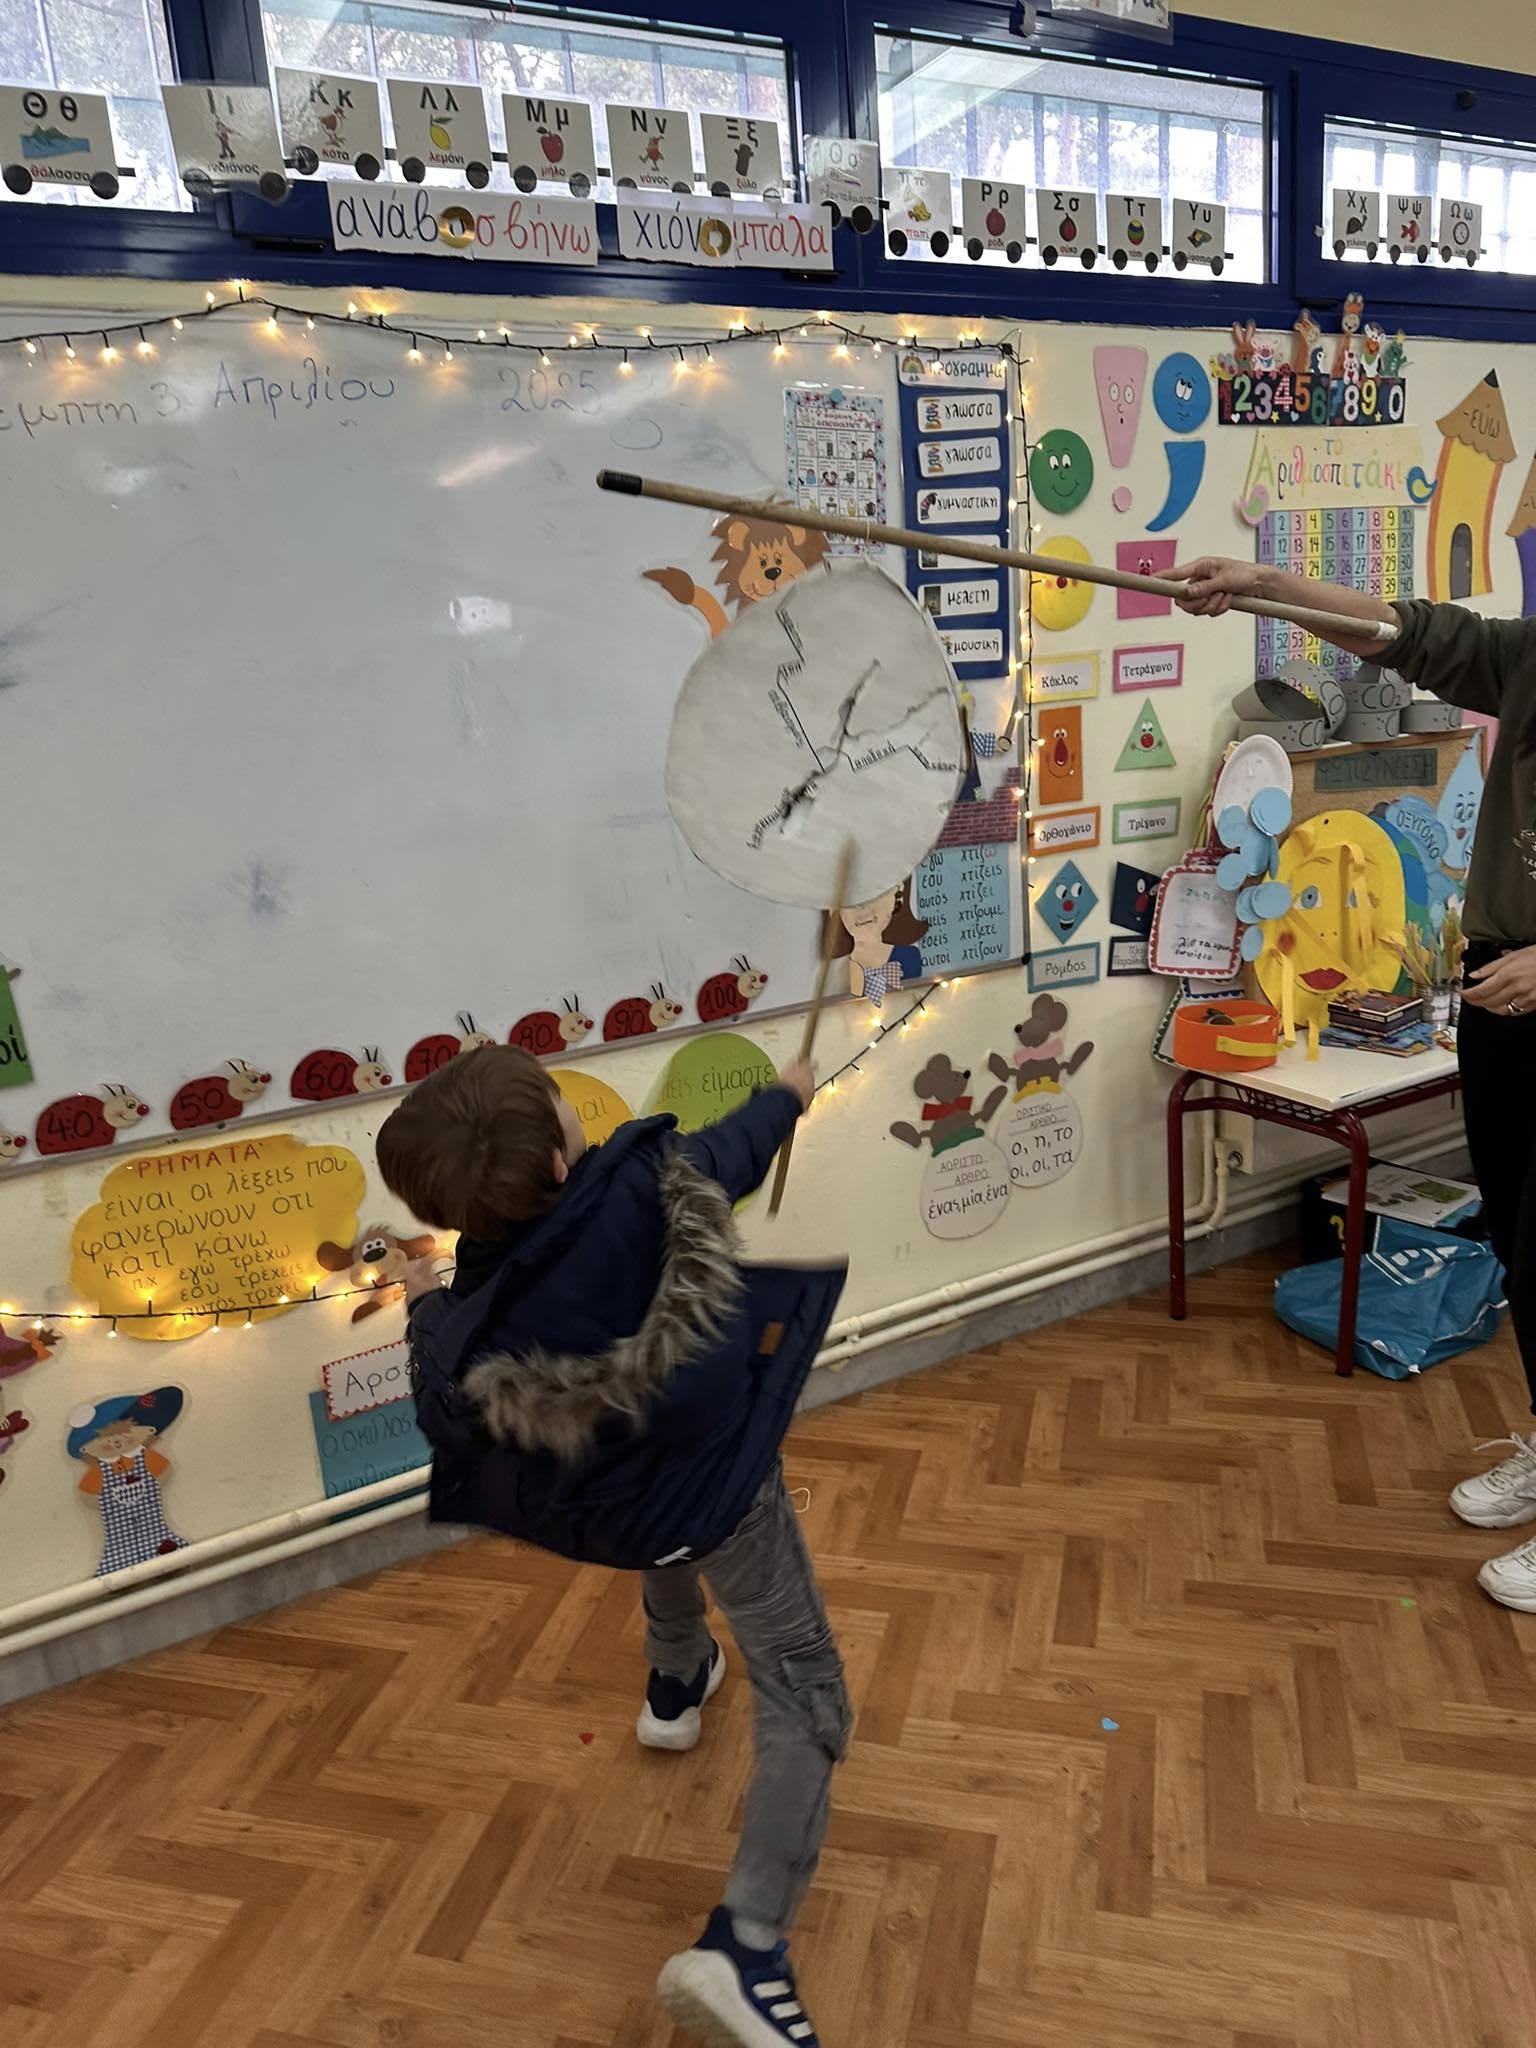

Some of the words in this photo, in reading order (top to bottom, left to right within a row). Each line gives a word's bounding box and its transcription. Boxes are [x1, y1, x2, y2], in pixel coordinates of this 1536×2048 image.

[429, 150, 464, 165] λεμόνι
[30, 164, 90, 181] θάλασσα
[541, 164, 566, 178] μήλο
[640, 174, 669, 187] νάνος
[150, 382, 181, 417] 3
[214, 358, 398, 420] Απριλίου
[498, 367, 602, 415] 2025
[1325, 439, 1344, 455] το
[1264, 515, 1269, 531] 1
[1279, 515, 1285, 531] 2
[1295, 514, 1302, 530] 3
[1309, 513, 1317, 529] 4
[1327, 513, 1334, 529] 5
[1341, 512, 1348, 528] 6
[1357, 512, 1364, 527] 7
[1373, 511, 1380, 527] 8
[1387, 510, 1395, 526] 9
[1401, 510, 1412, 525] 10
[1278, 539, 1287, 553] 12
[1294, 539, 1303, 553] 13
[1309, 537, 1319, 552] 14
[1325, 537, 1335, 551] 15
[1341, 536, 1350, 550] 16
[1356, 535, 1365, 549] 17
[1372, 534, 1381, 549] 18
[1386, 533, 1396, 548] 19
[1401, 532, 1412, 547] 20
[1308, 560, 1320, 577] 24
[1324, 560, 1336, 576] 25
[1355, 557, 1366, 572] 27
[1370, 557, 1381, 573] 28
[1385, 556, 1396, 573] 29
[1400, 555, 1412, 571] 30
[1370, 579, 1381, 596] 38
[1385, 578, 1396, 594] 39
[1400, 577, 1413, 592] 40
[1261, 634, 1270, 651] 51
[1276, 633, 1288, 649] 52
[1292, 632, 1303, 648] 53
[1122, 662, 1173, 678] Τετράγωνο
[1258, 659, 1268, 675] 61
[1323, 651, 1334, 667] 65
[1041, 674, 1078, 688] Κύκλος
[1128, 815, 1166, 830] Τρίγωνο
[961, 865, 1002, 882] χτίζεις
[920, 891, 948, 908] αυτός
[962, 943, 1003, 961] χτίζουν
[1045, 960, 1087, 978] Ρόμβος
[703, 983, 737, 1014] 100
[615, 1009, 645, 1038] 90
[519, 1022, 553, 1050] 80
[415, 1047, 452, 1075] 70
[305, 1062, 347, 1091] 60
[180, 1087, 225, 1122] 50
[47, 1110, 95, 1143] 40
[104, 1191, 175, 1221] είναι
[190, 1181, 212, 1202] οι
[227, 1168, 294, 1195] λέξεις
[81, 1201, 257, 1263] φανερώνουν
[272, 1191, 313, 1215] ότι
[103, 1250, 174, 1279] κάτι
[195, 1230, 267, 1259] κάνω
[179, 1260, 215, 1286] εγώ
[230, 1244, 291, 1272] τρέχω
[235, 1264, 303, 1288] τρέχεις
